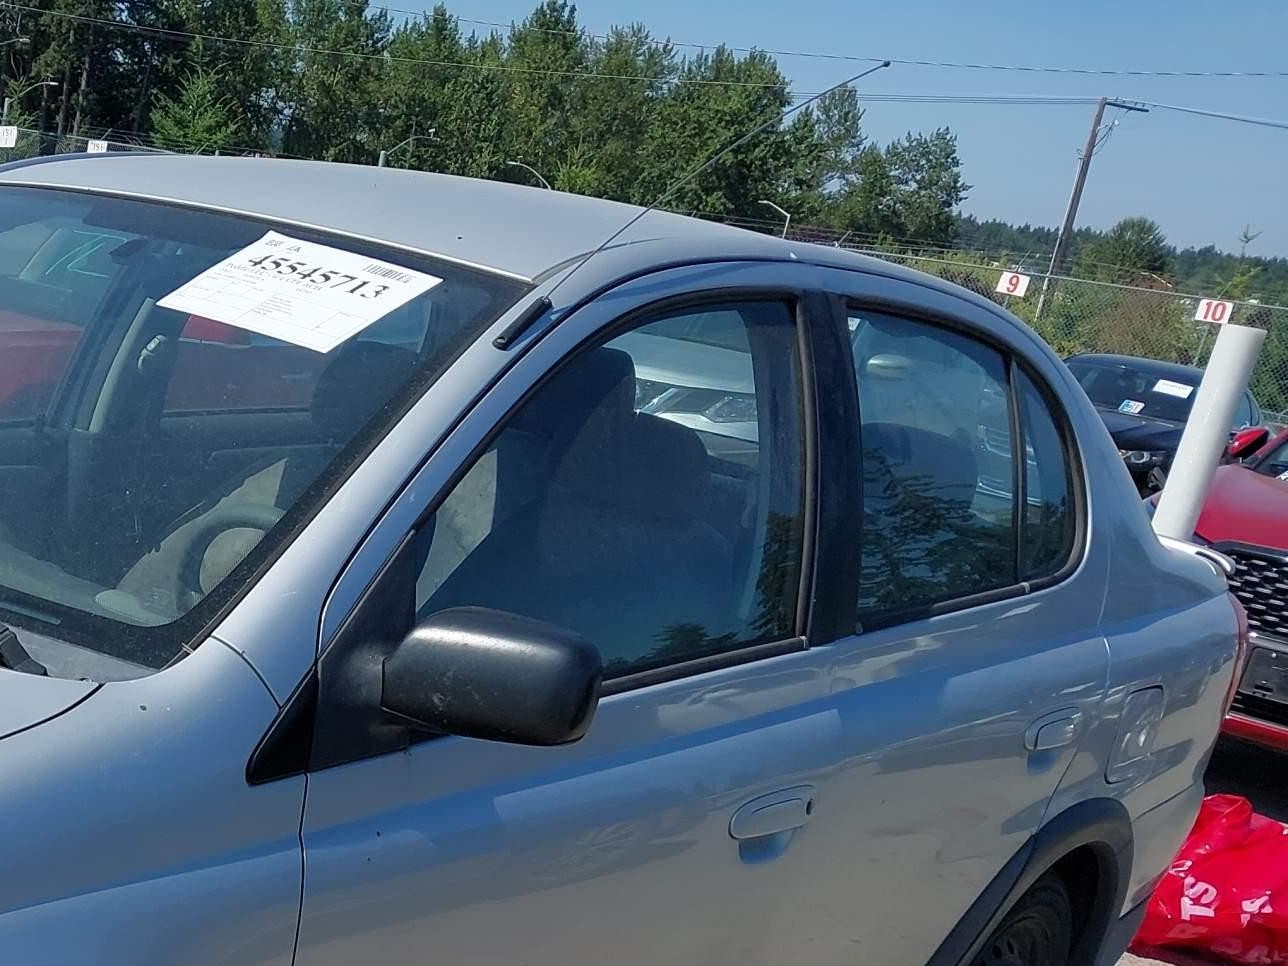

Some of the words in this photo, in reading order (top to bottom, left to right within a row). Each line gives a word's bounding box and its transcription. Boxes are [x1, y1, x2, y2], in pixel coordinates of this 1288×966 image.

[248, 254, 390, 298] 45545713
[1006, 275, 1020, 293] 9
[1203, 301, 1227, 321] 10
